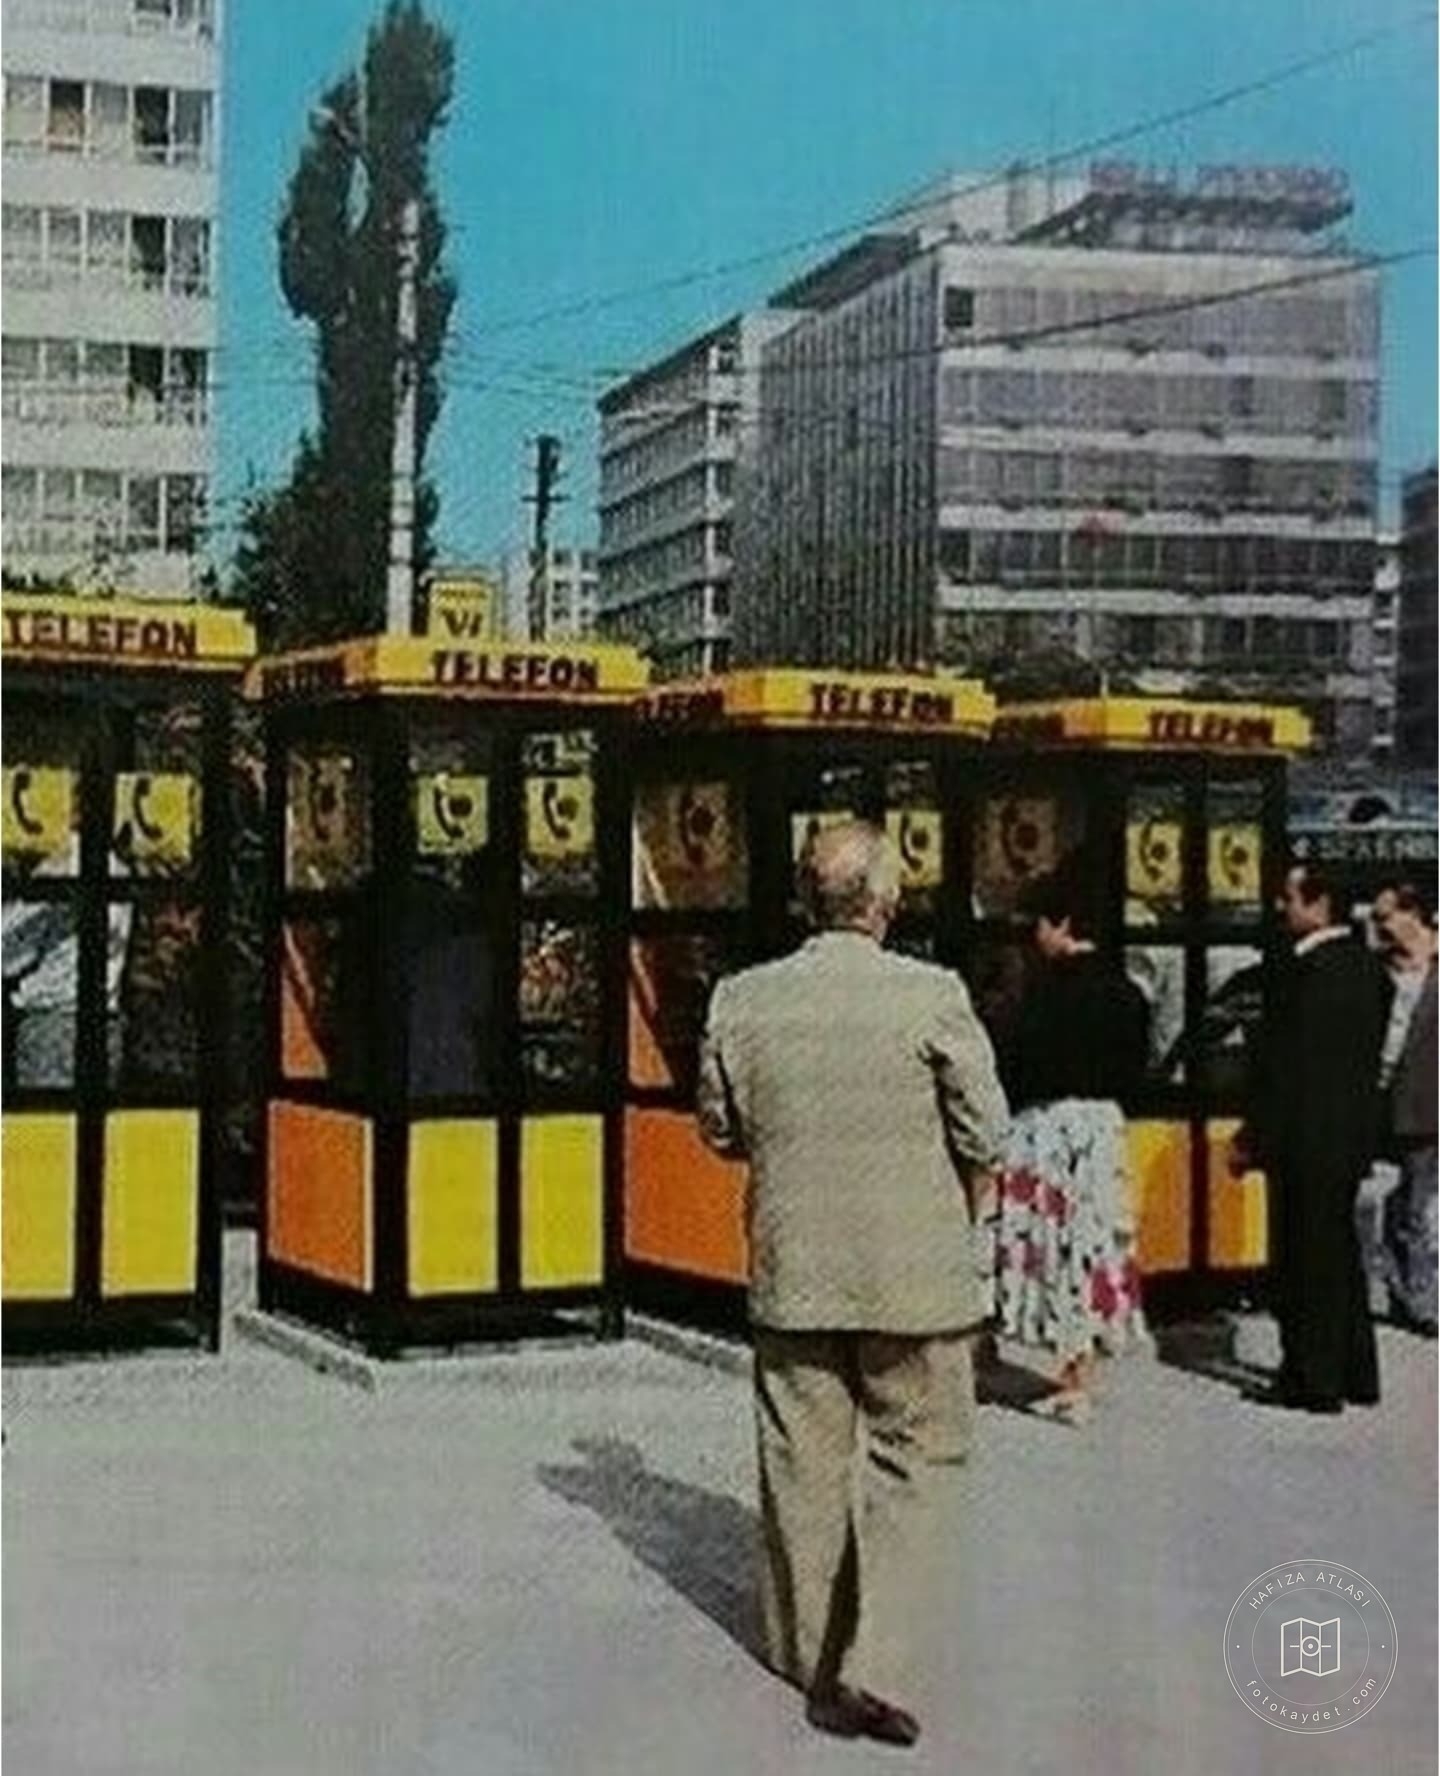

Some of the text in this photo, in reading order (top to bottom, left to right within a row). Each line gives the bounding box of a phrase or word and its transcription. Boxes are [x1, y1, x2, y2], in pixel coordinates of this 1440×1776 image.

[5, 610, 197, 657] TELEFON
[434, 651, 598, 693] TELEFON
[811, 683, 955, 723] TELEFON
